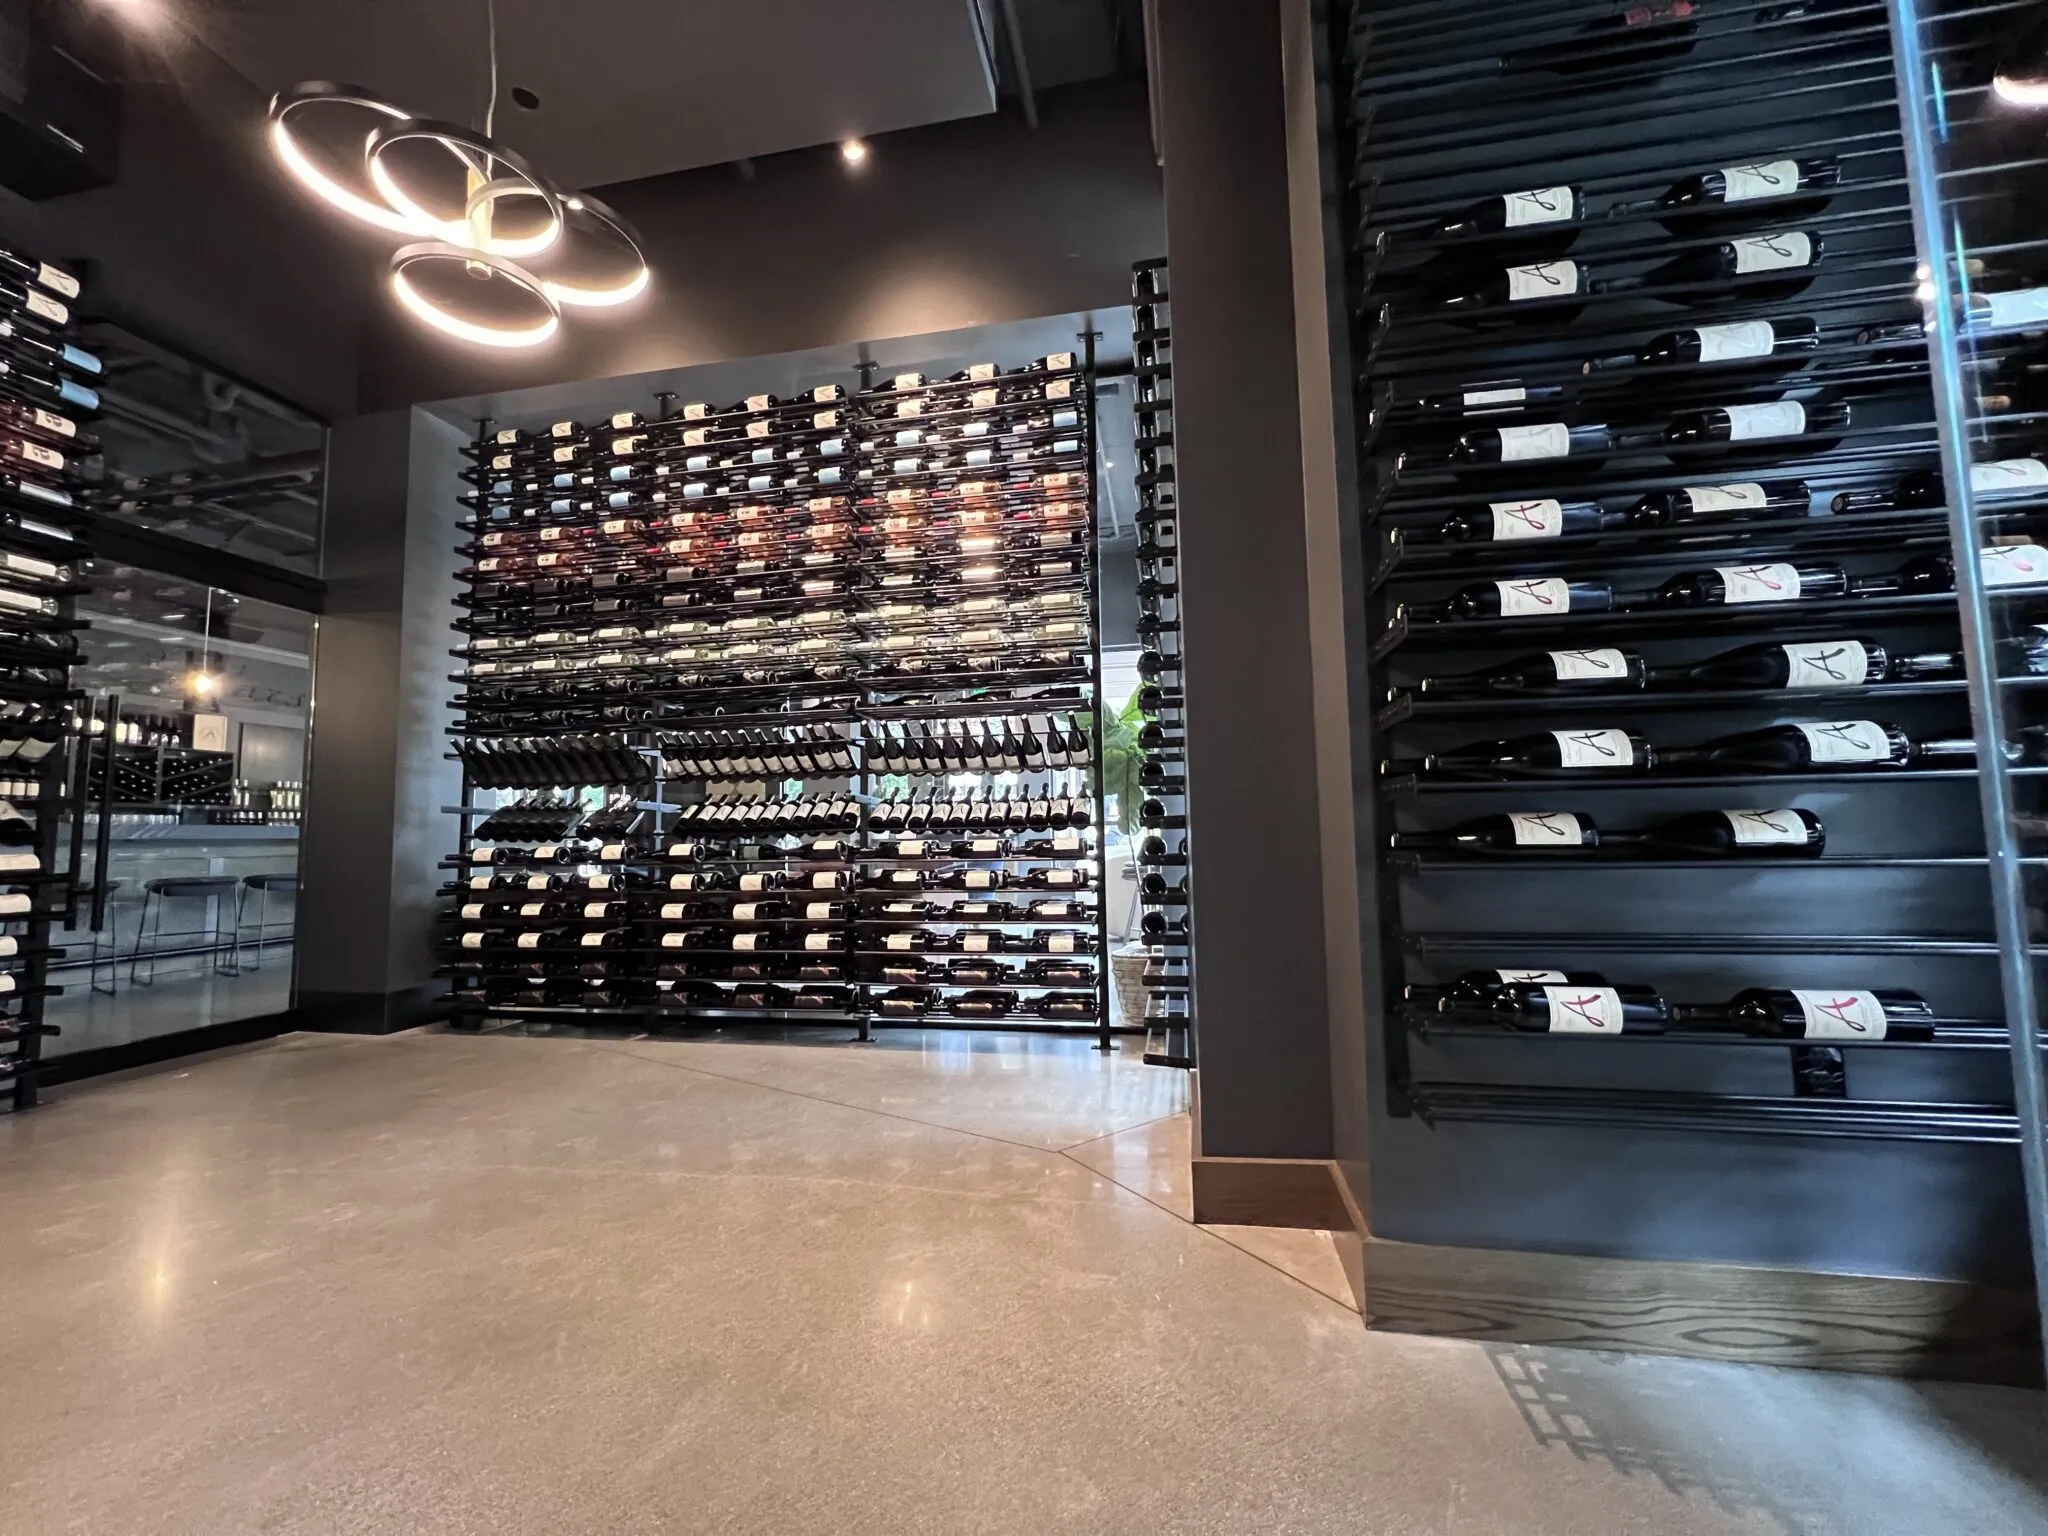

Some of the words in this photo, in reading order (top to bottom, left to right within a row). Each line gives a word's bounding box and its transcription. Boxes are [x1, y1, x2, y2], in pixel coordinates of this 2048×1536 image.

[1504, 502, 1546, 530] A
[1733, 565, 1783, 591] A
[1509, 580, 1552, 605] A
[1801, 648, 1846, 681] A
[1568, 732, 1616, 757] A
[1816, 723, 1871, 750] A
[1521, 814, 1566, 836] A
[1738, 810, 1788, 833] A
[1560, 994, 1605, 1028] A
[1814, 996, 1867, 1032] A
